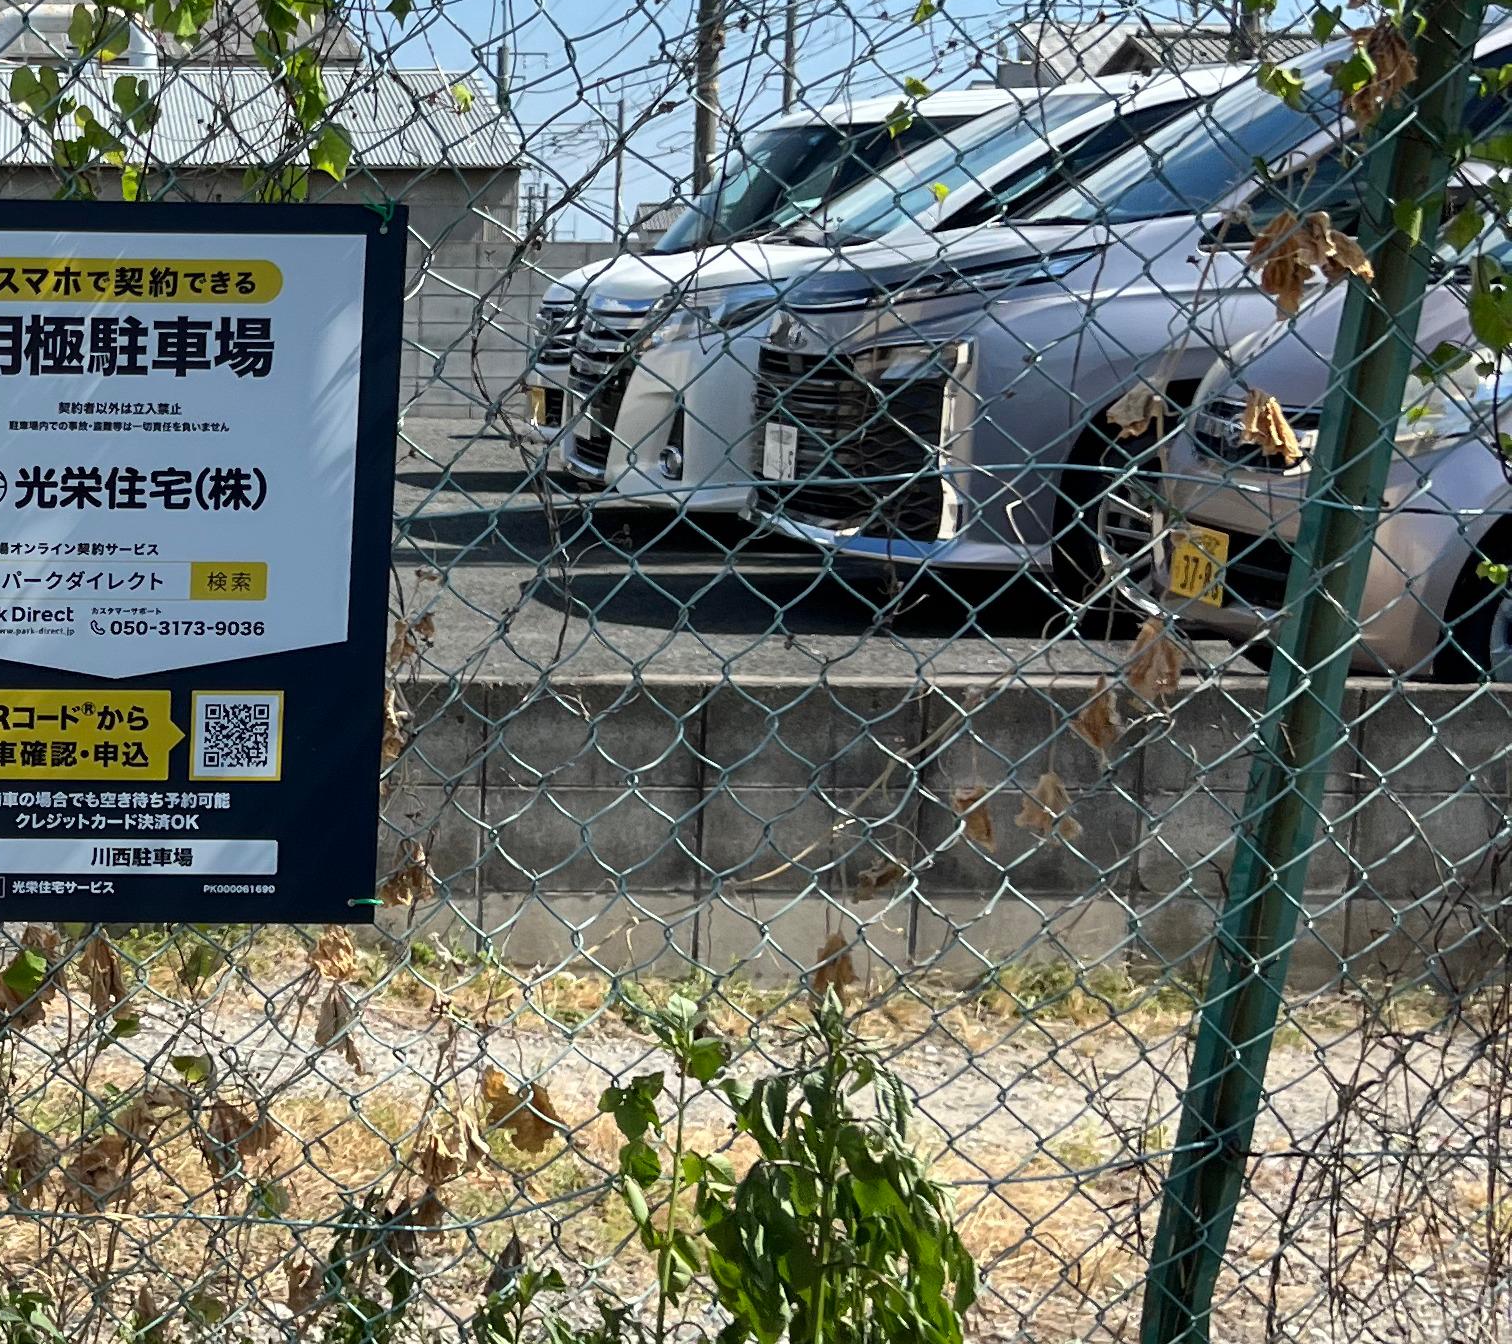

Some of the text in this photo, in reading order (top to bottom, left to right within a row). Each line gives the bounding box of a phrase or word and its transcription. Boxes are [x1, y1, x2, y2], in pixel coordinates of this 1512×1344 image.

[58, 401, 183, 416] 契約者以外は立入禁止
[1, 570, 164, 591] パークダイレクト
[206, 571, 252, 593] 検索
[11, 606, 75, 623] Direct
[110, 620, 265, 637] 050-3173-9036
[15, 812, 200, 831] クレジットカード決済OK
[90, 847, 194, 868] 川西駐車場
[12, 880, 115, 895] 光栄住宅サービス
